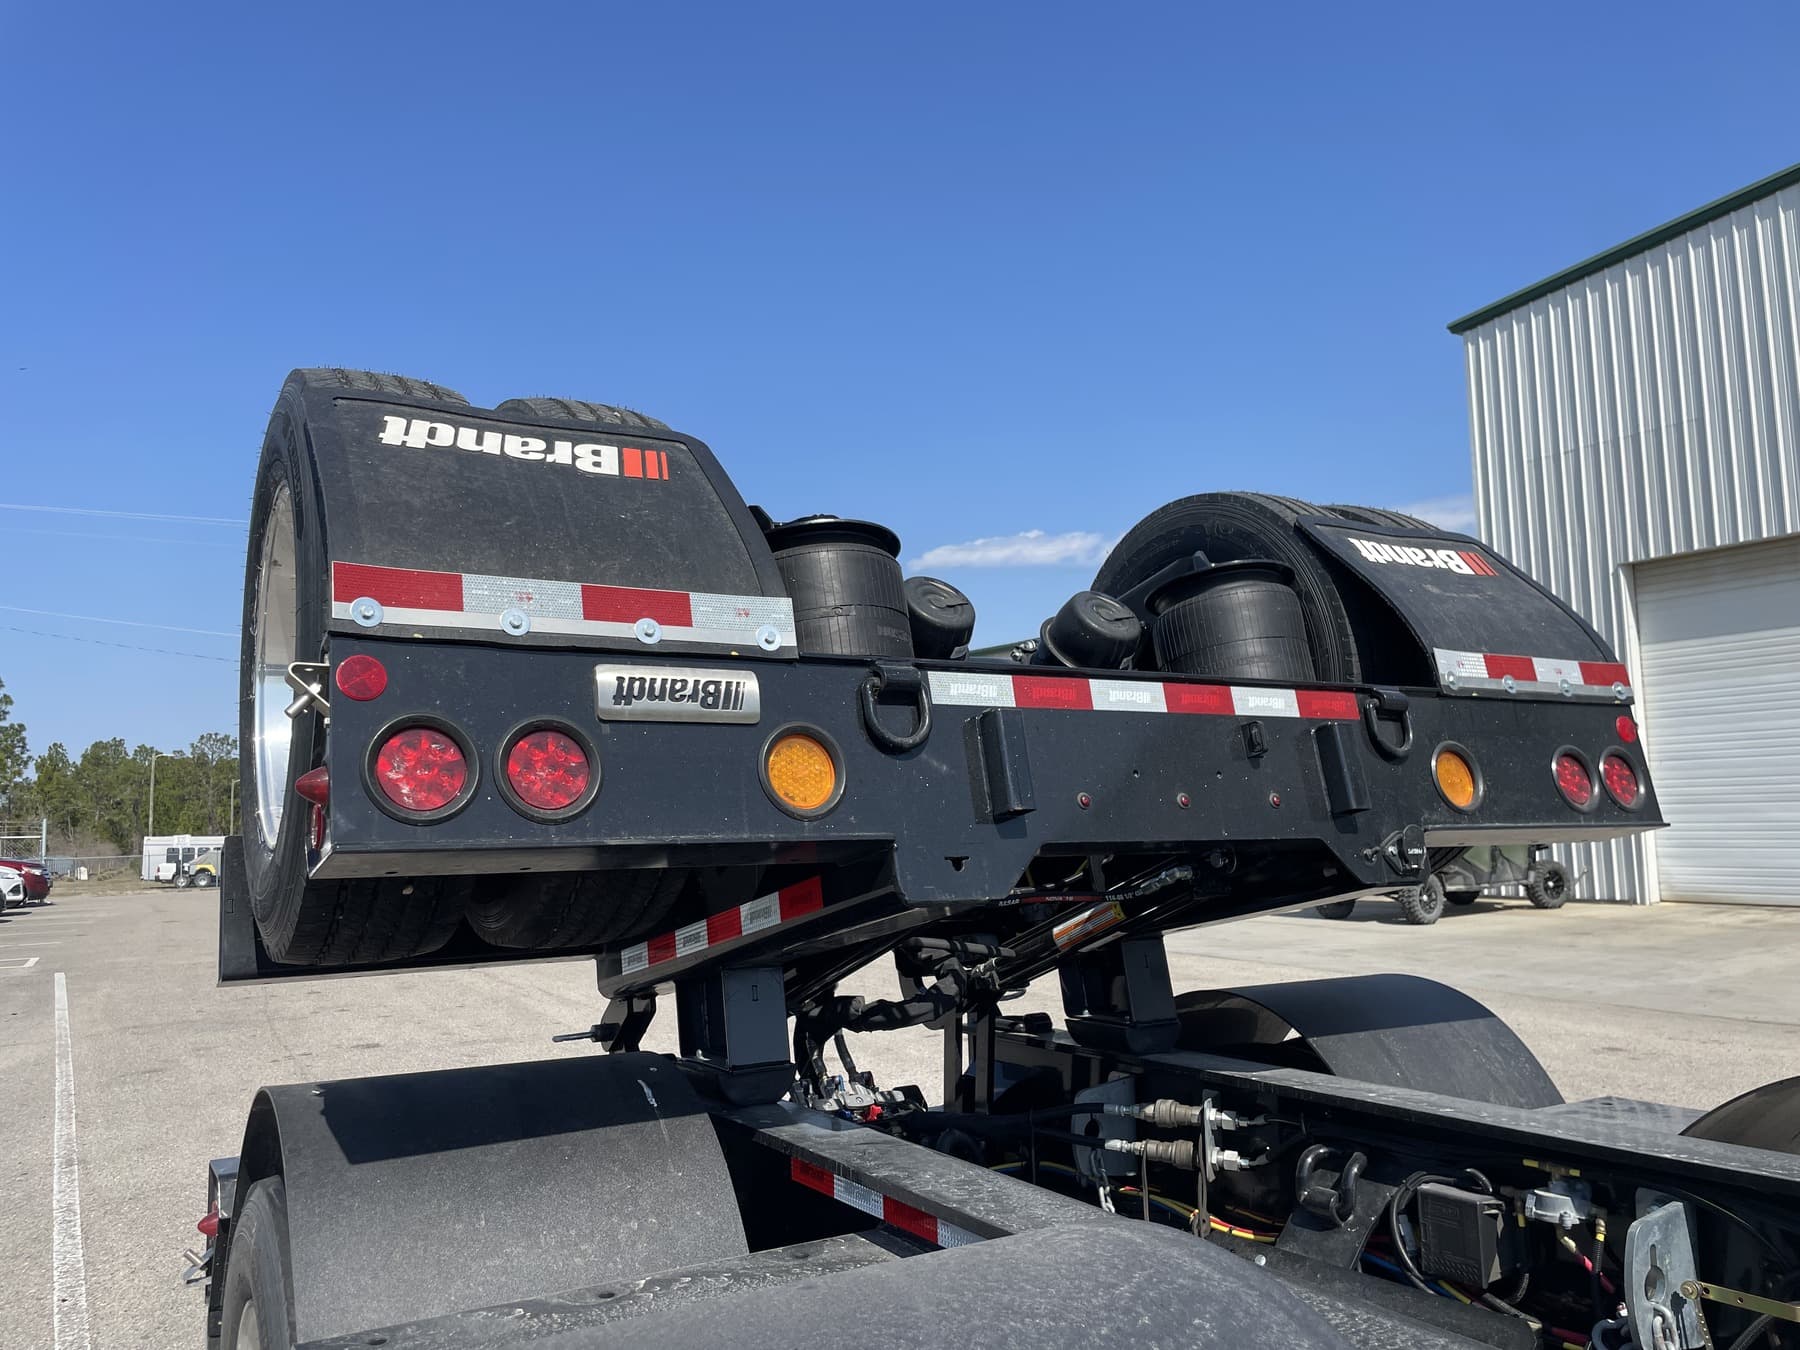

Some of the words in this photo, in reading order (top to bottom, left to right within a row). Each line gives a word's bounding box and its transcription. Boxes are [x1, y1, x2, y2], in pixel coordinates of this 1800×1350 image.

[378, 415, 620, 476] Brandt
[1347, 537, 1476, 576] Brandt
[612, 675, 723, 711] Brandt
[950, 682, 992, 698] Brandt
[1032, 686, 1071, 702] Brandt
[1109, 689, 1145, 704] Brandt
[1249, 695, 1279, 710] Brandt
